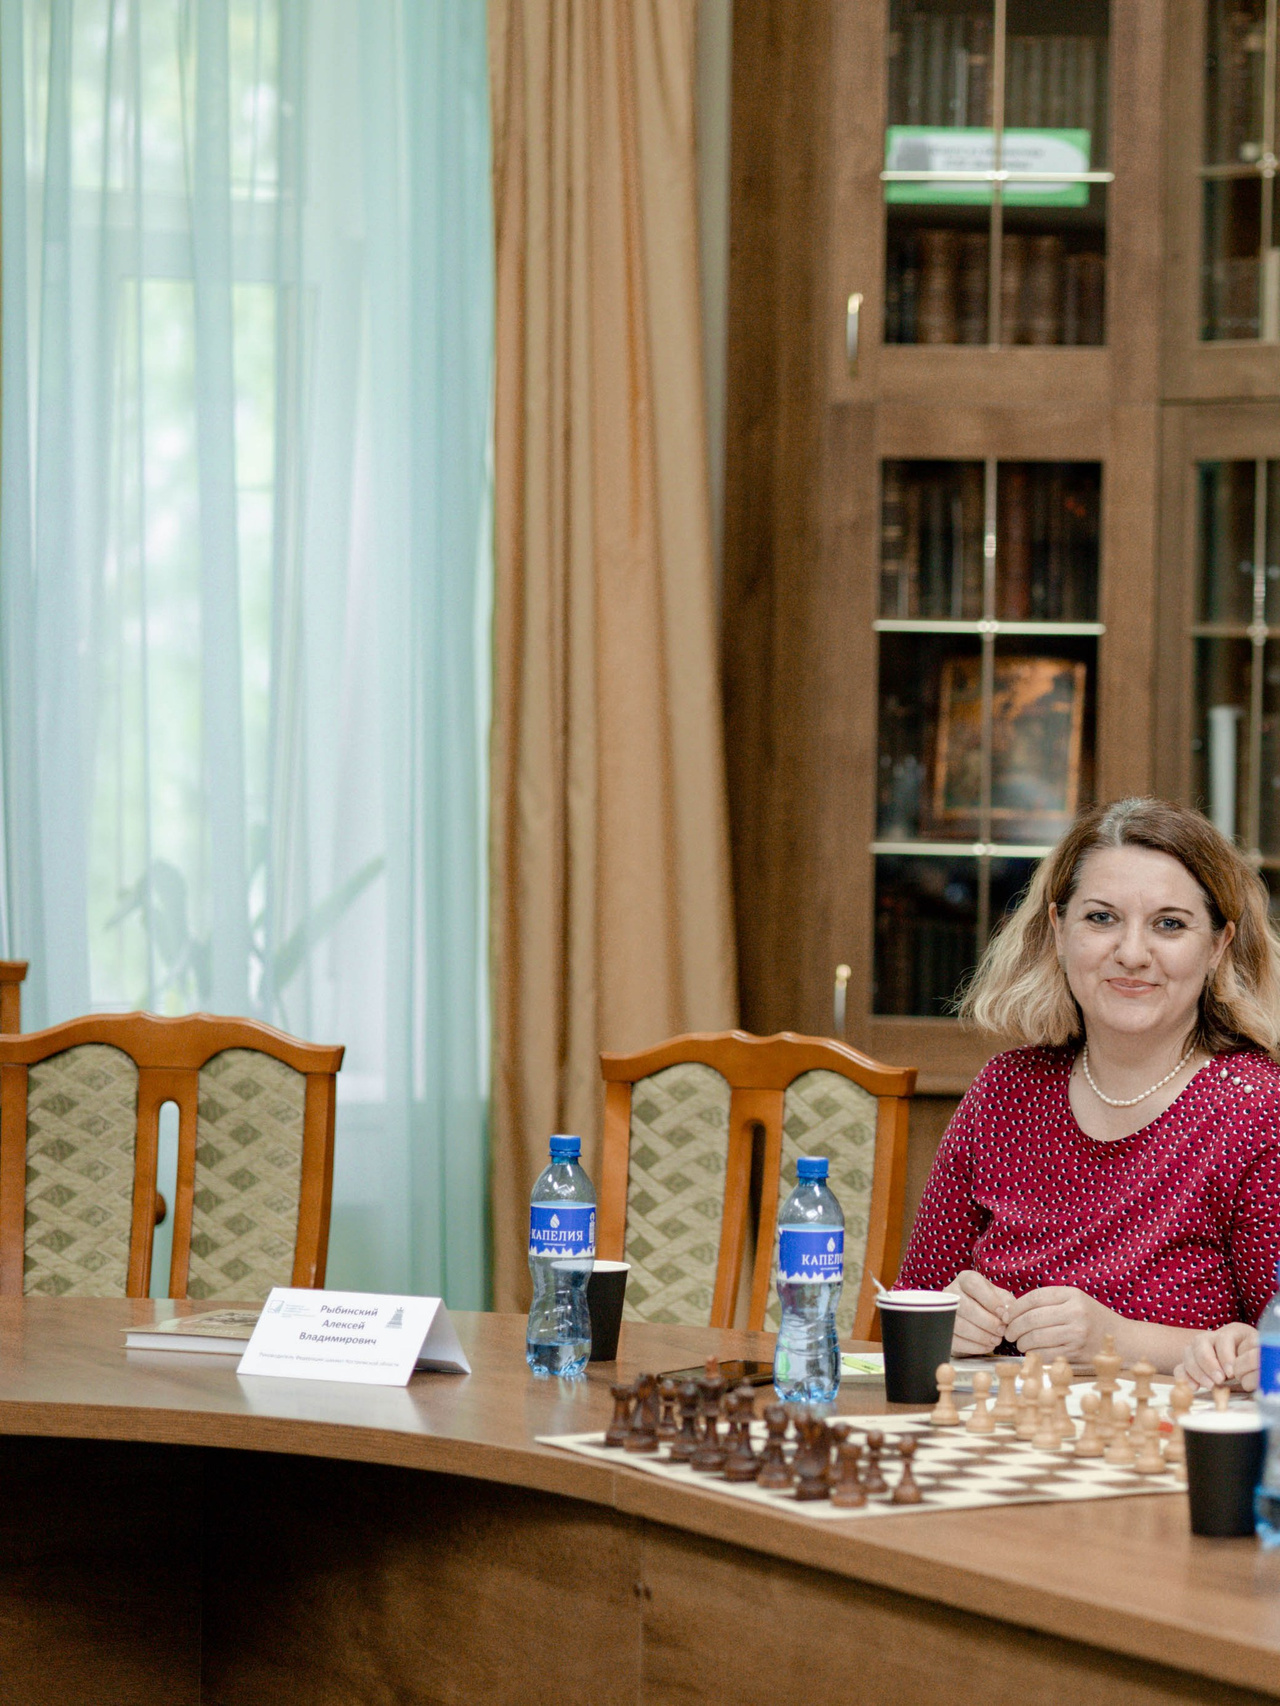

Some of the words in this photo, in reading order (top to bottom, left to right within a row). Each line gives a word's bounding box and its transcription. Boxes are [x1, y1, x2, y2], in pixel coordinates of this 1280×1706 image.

[531, 1228, 584, 1242] КАПЕЛИЯ
[320, 1304, 379, 1317] Рыбинский
[321, 1319, 366, 1330] Алексей
[299, 1331, 378, 1345] Владимирович
